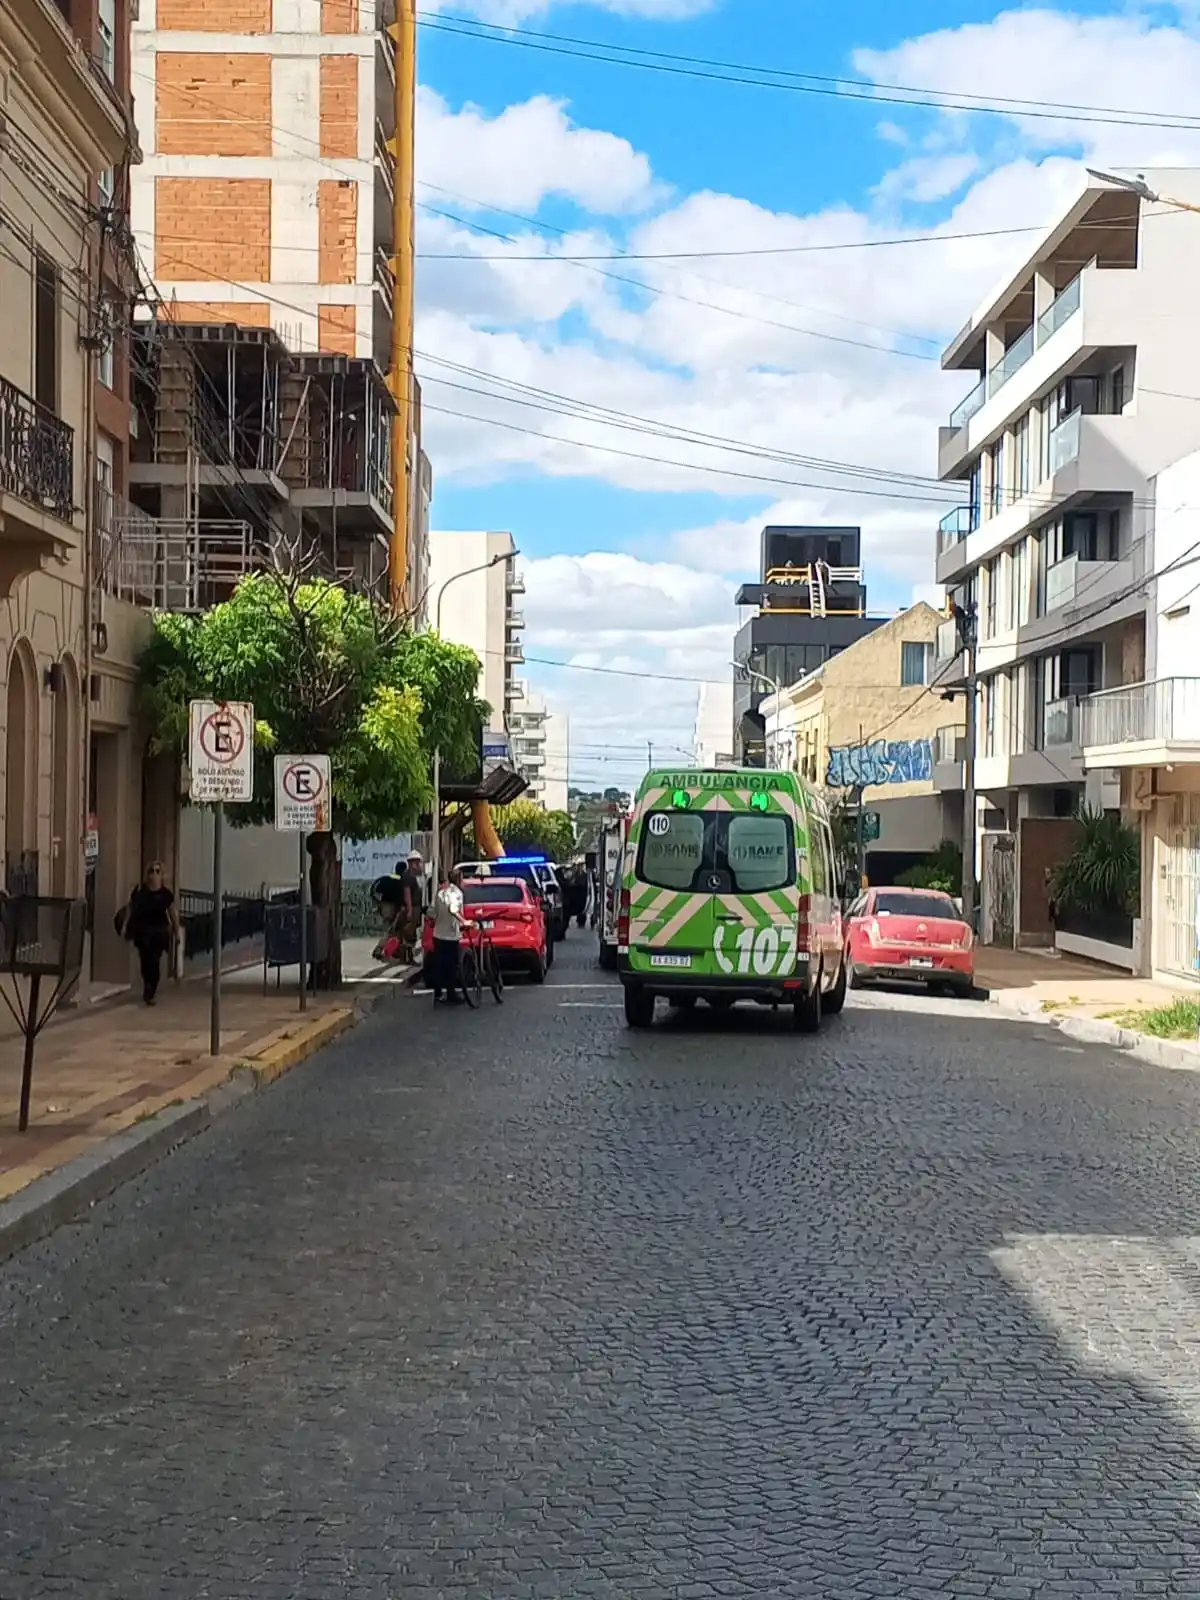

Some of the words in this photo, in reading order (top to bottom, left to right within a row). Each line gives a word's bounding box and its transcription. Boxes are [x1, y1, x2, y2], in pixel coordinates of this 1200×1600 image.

[296, 770, 311, 793] E
[660, 774, 780, 791] AMBULANCIA
[651, 817, 669, 832] 110
[735, 923, 796, 976] 107
